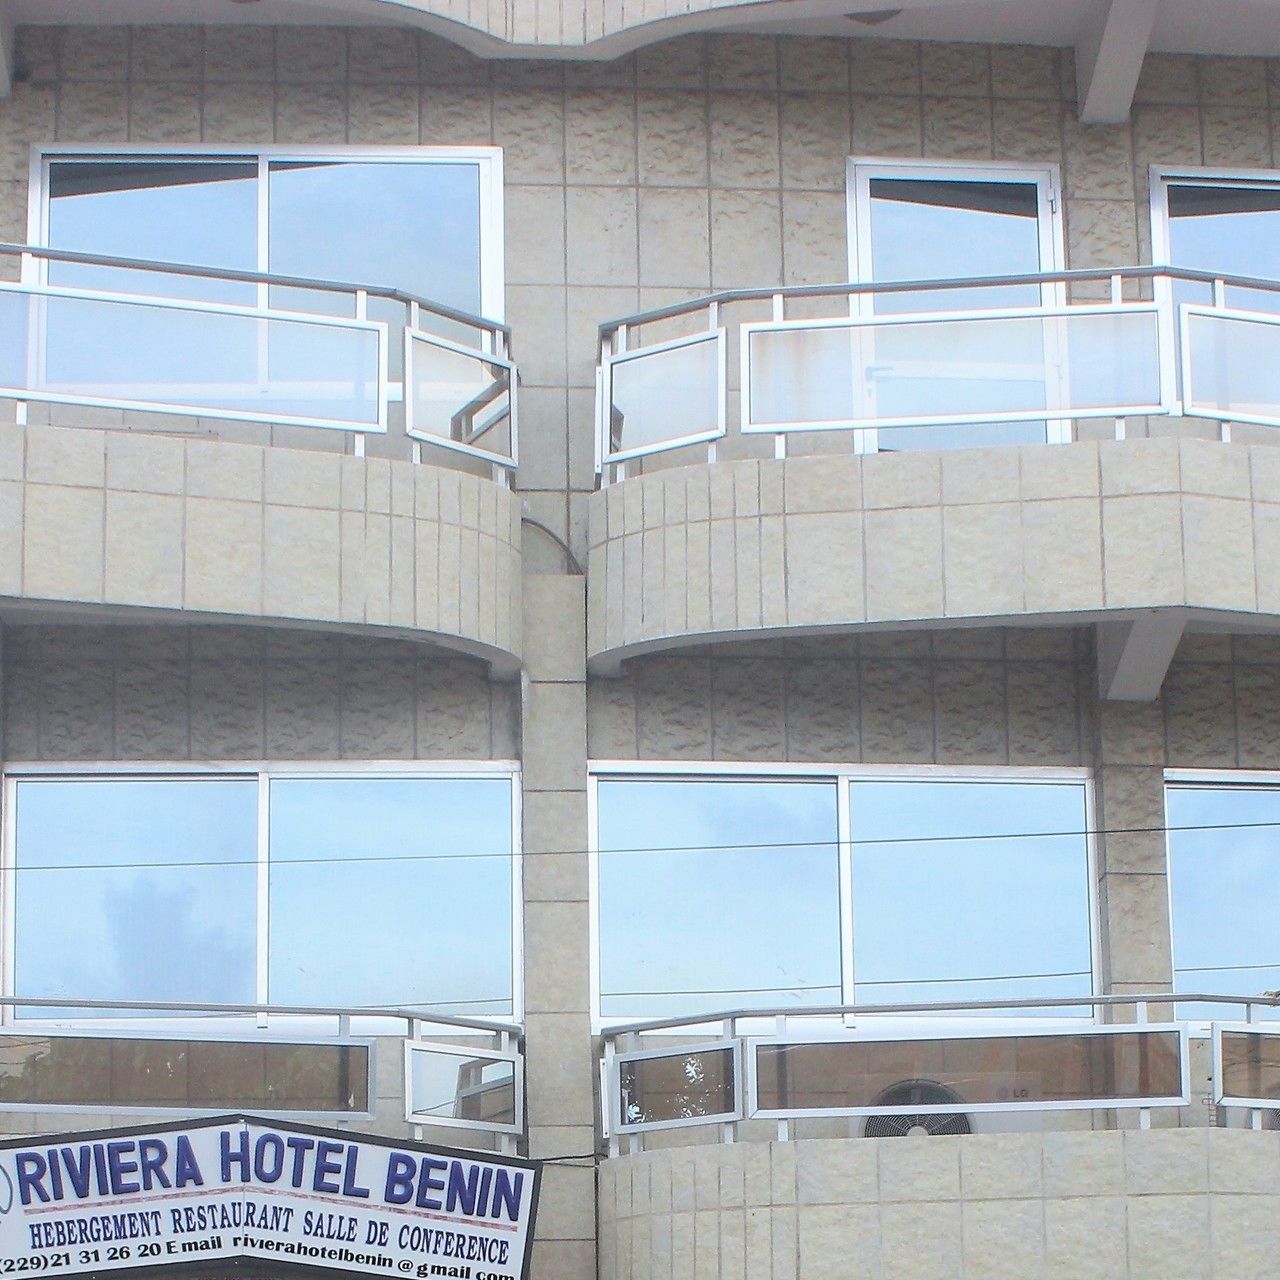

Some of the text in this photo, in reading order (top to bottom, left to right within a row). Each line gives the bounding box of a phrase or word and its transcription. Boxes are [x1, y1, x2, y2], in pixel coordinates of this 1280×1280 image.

[15, 1131, 524, 1222] RIVIERA HOTEL BENIN
[29, 1201, 510, 1265] HEBERGEMENT RESTAURANT SALLE DE CONFERENCE
[79, 1249, 100, 1265] 31
[106, 1246, 131, 1262] 26
[137, 1242, 161, 1257] 20
